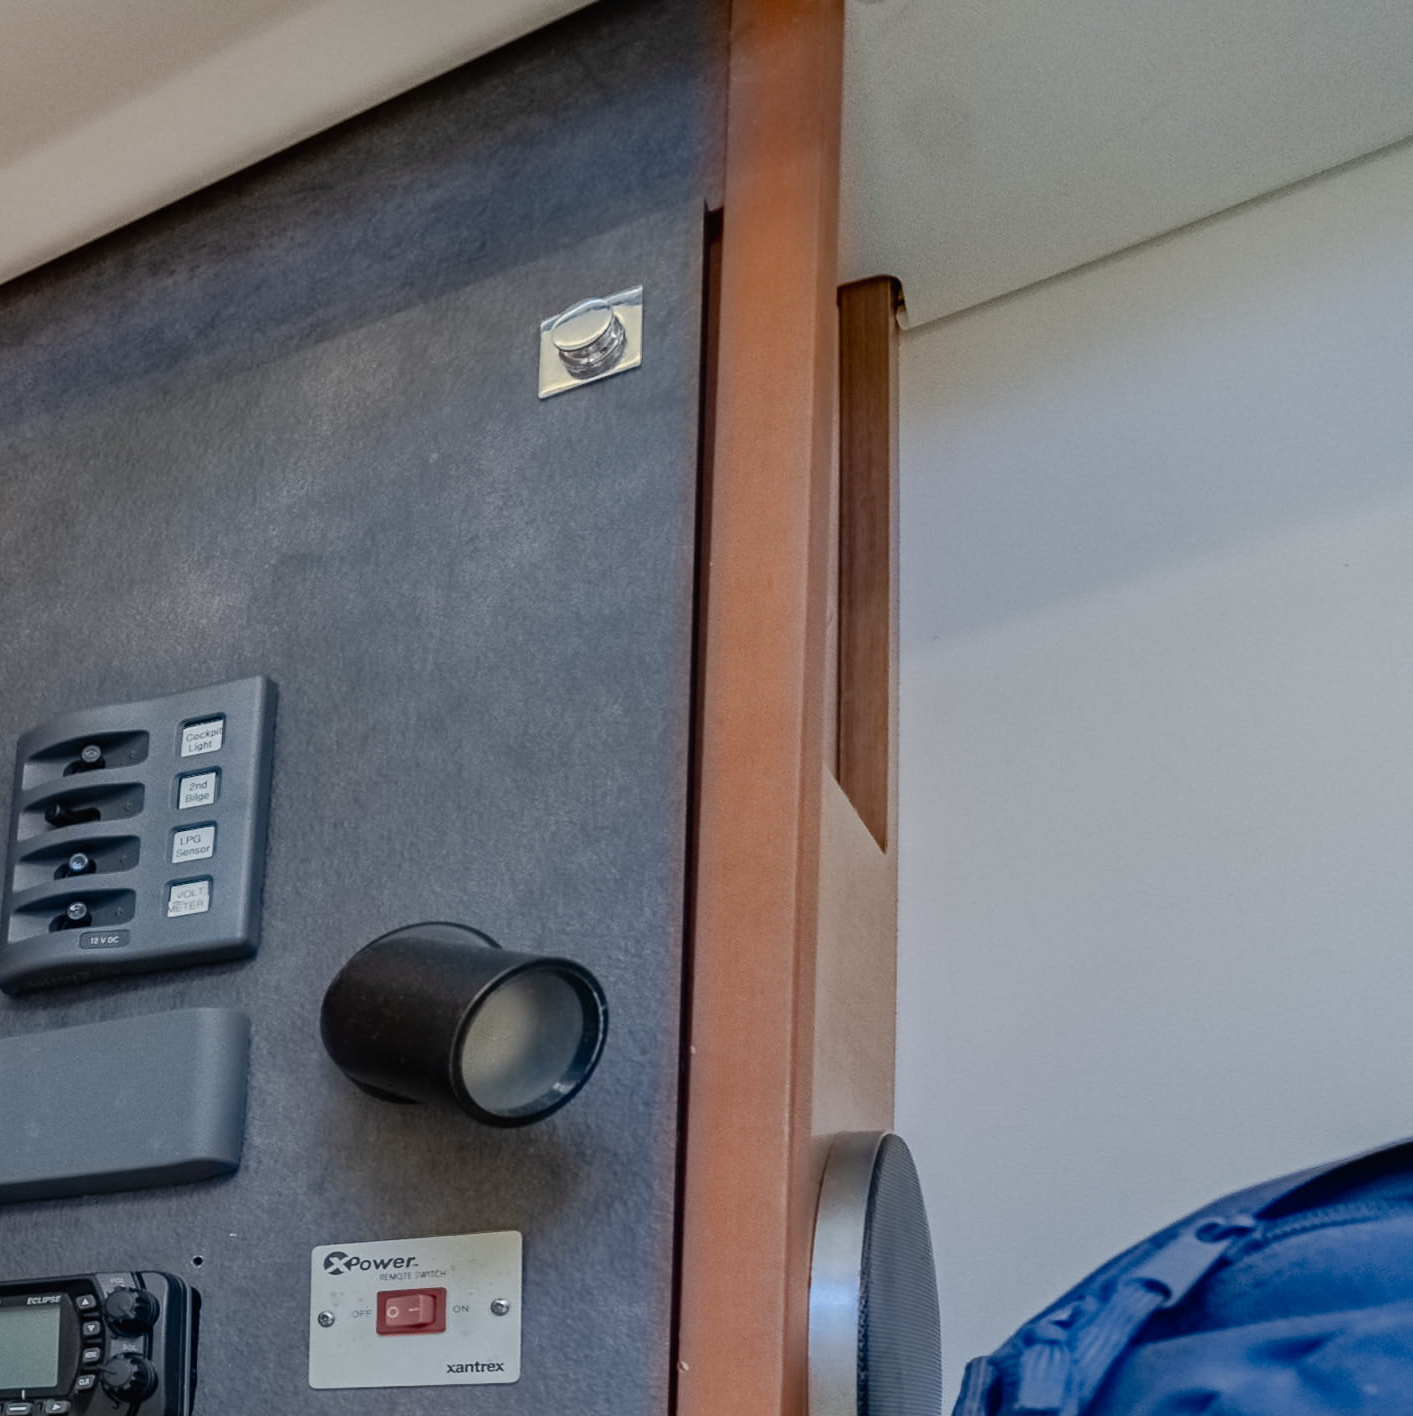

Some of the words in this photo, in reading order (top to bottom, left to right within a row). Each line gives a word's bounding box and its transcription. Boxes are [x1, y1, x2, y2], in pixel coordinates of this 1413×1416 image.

[186, 727, 222, 742] Cockpit
[188, 741, 212, 752] Light
[189, 781, 208, 791] 2nd
[185, 792, 210, 804] Bilge
[180, 835, 201, 846] LPG
[176, 845, 210, 858] Sensor
[177, 887, 204, 899] VOLT
[380, 1273, 412, 1281] REMOTE
[415, 1270, 447, 1279] SWITCH
[26, 1295, 61, 1305] ECLIPSE
[352, 1310, 373, 1318] OFF
[453, 1305, 469, 1313] ON
[446, 1361, 504, 1374] xantrex
